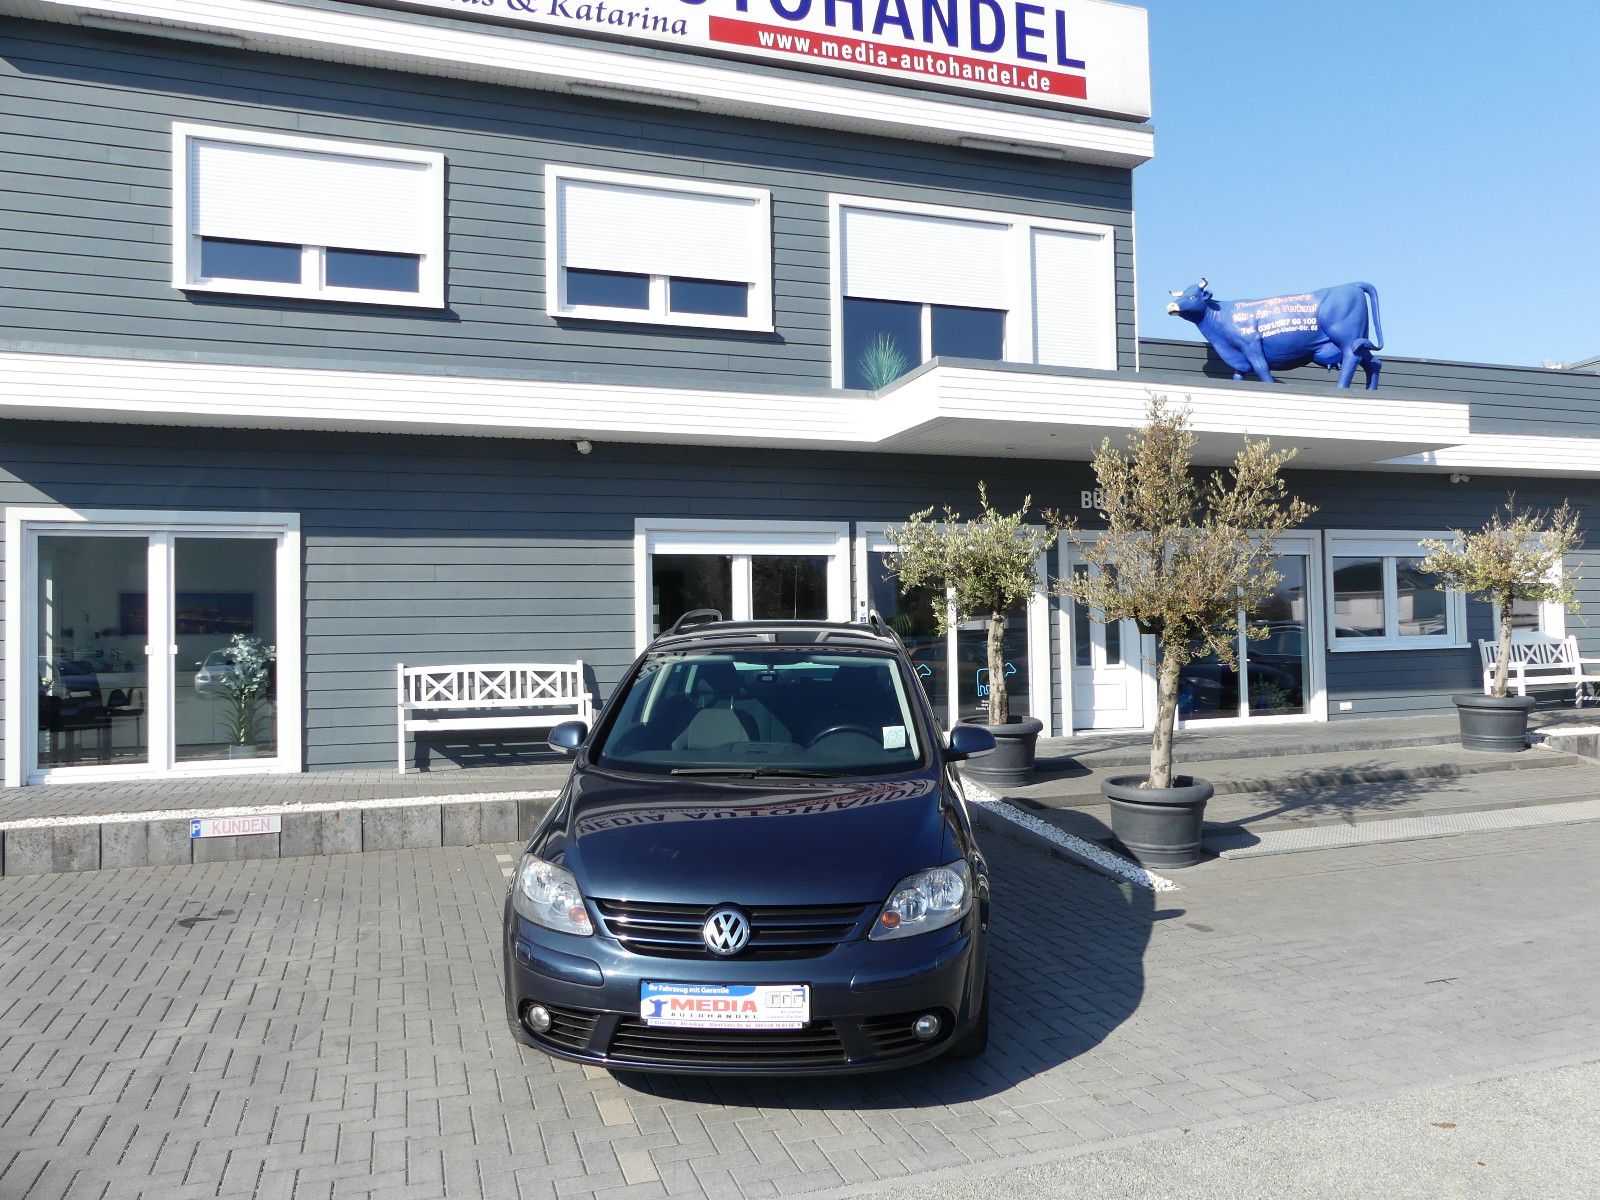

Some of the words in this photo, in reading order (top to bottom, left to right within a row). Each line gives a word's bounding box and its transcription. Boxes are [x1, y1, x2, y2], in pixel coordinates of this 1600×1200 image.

[547, 0, 688, 36] Katarina
[758, 30, 1050, 91] www.media-autohandel.de
[212, 818, 270, 835] KUNDEN
[659, 985, 689, 995] Fahrzeug
[670, 998, 757, 1012] MEDIA
